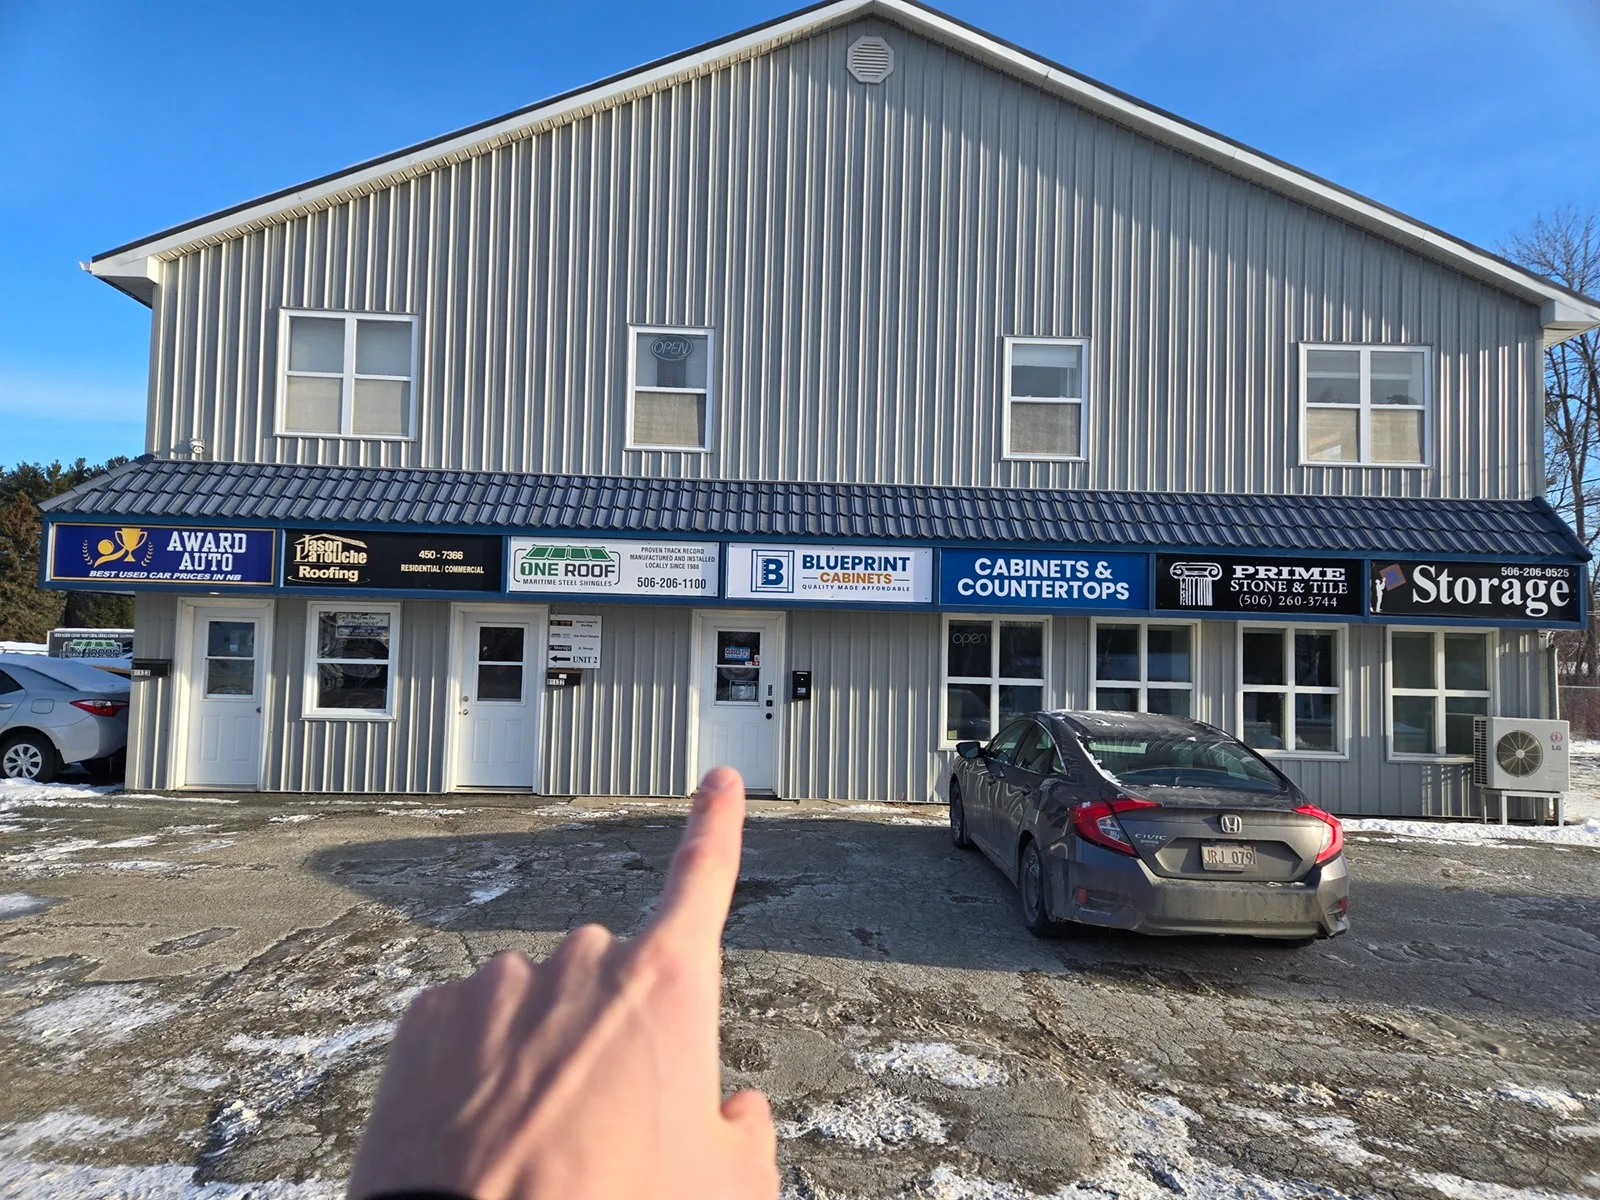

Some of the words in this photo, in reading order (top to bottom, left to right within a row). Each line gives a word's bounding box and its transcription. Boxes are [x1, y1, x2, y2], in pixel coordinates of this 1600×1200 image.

[654, 341, 689, 354] OPEN
[167, 531, 247, 554] AWARD
[301, 534, 342, 556] Jason
[179, 552, 233, 571] AUTO
[630, 554, 673, 562] MANUFACTURED
[802, 554, 910, 572] BLUEPRINT
[299, 564, 359, 582] Roofing
[401, 564, 440, 573] RESIDENTIAL
[445, 565, 484, 574] COMMERCIAL
[520, 562, 559, 576] ONE
[564, 563, 616, 578] ROOF
[761, 558, 784, 586] B
[974, 557, 1089, 579] CABINETS
[1095, 560, 1113, 579] &
[1232, 565, 1346, 580] PRIME
[1501, 566, 1569, 578] 506-206-0525
[89, 570, 118, 578] BEST
[118, 571, 148, 579] USED
[149, 572, 172, 580] CAR
[172, 572, 211, 580] PRICES
[212, 573, 224, 581] IN
[820, 572, 892, 584] CABINETS
[637, 577, 706, 589] 506-206-1100
[957, 578, 1129, 600] COUNTERTOPS
[1230, 580, 1288, 592] STONE
[1293, 582, 1304, 593] &
[1308, 582, 1348, 594] TILE
[1412, 564, 1570, 617] Storage
[1239, 594, 1273, 607] (506)
[1278, 596, 1338, 607] 260-3744
[952, 633, 987, 646] open
[1204, 850, 1225, 864] JRJ
